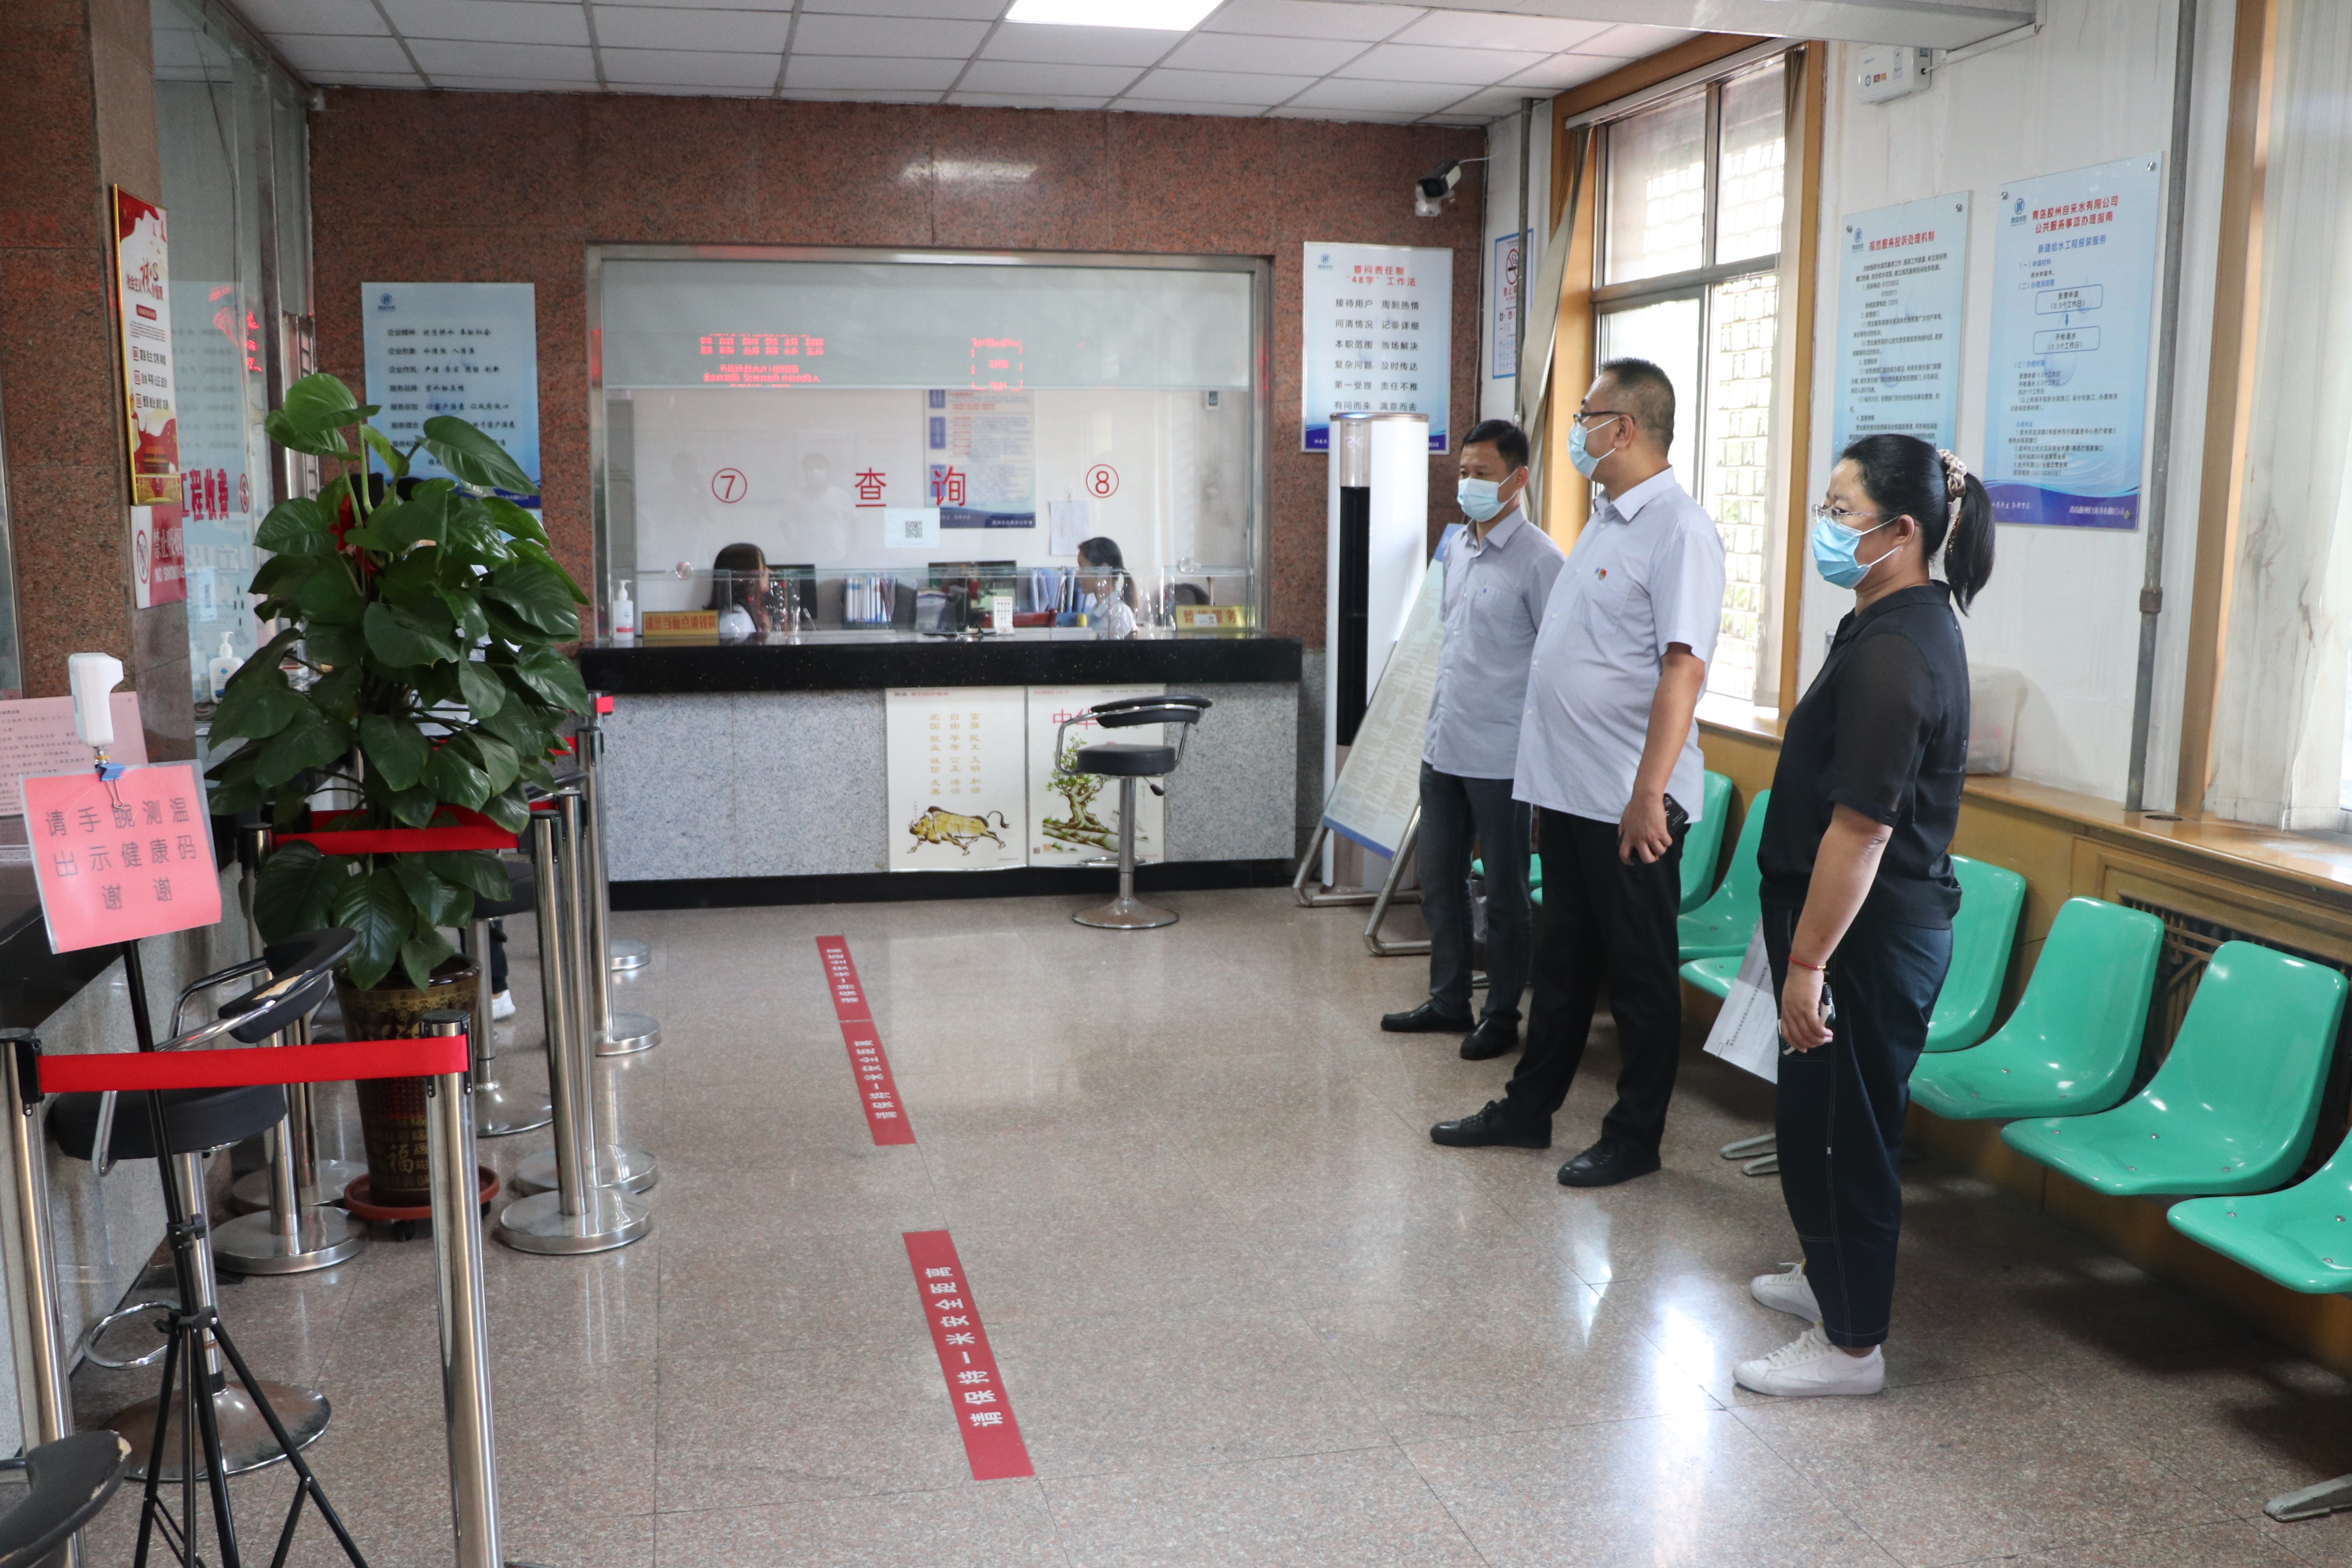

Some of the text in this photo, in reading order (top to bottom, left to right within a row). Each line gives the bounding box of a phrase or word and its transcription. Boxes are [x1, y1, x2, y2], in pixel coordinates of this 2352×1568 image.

[2033, 196, 2118, 220] 青岛胶州自来水有限公司
[2035, 211, 2113, 233] 公共服务事项办理指南
[1870, 230, 1935, 251] 规范服务投诉处理机制
[2038, 235, 2106, 254] 新建给水工程报装服务
[1354, 265, 1404, 275] 首问责任制
[1387, 277, 1416, 286] 工作法
[2058, 291, 2078, 300] 受理申请
[1336, 298, 1419, 310] 接待用户 周到热情
[1336, 319, 1419, 330] 问清情况 记录详细
[1335, 339, 1418, 351] 本职范围 当场解决
[1335, 360, 1418, 371] 复杂问题 及时传达
[1335, 380, 1418, 391] 第一受理 责任不推
[1335, 401, 1417, 411] 有问而来 满意而去
[181, 469, 229, 522] 工程收费
[46, 797, 190, 837] 请手腕测温
[54, 835, 197, 877] 出示健康码
[101, 878, 172, 910] 谢谢
[925, 1266, 1003, 1427] 请保持一米安全距离
